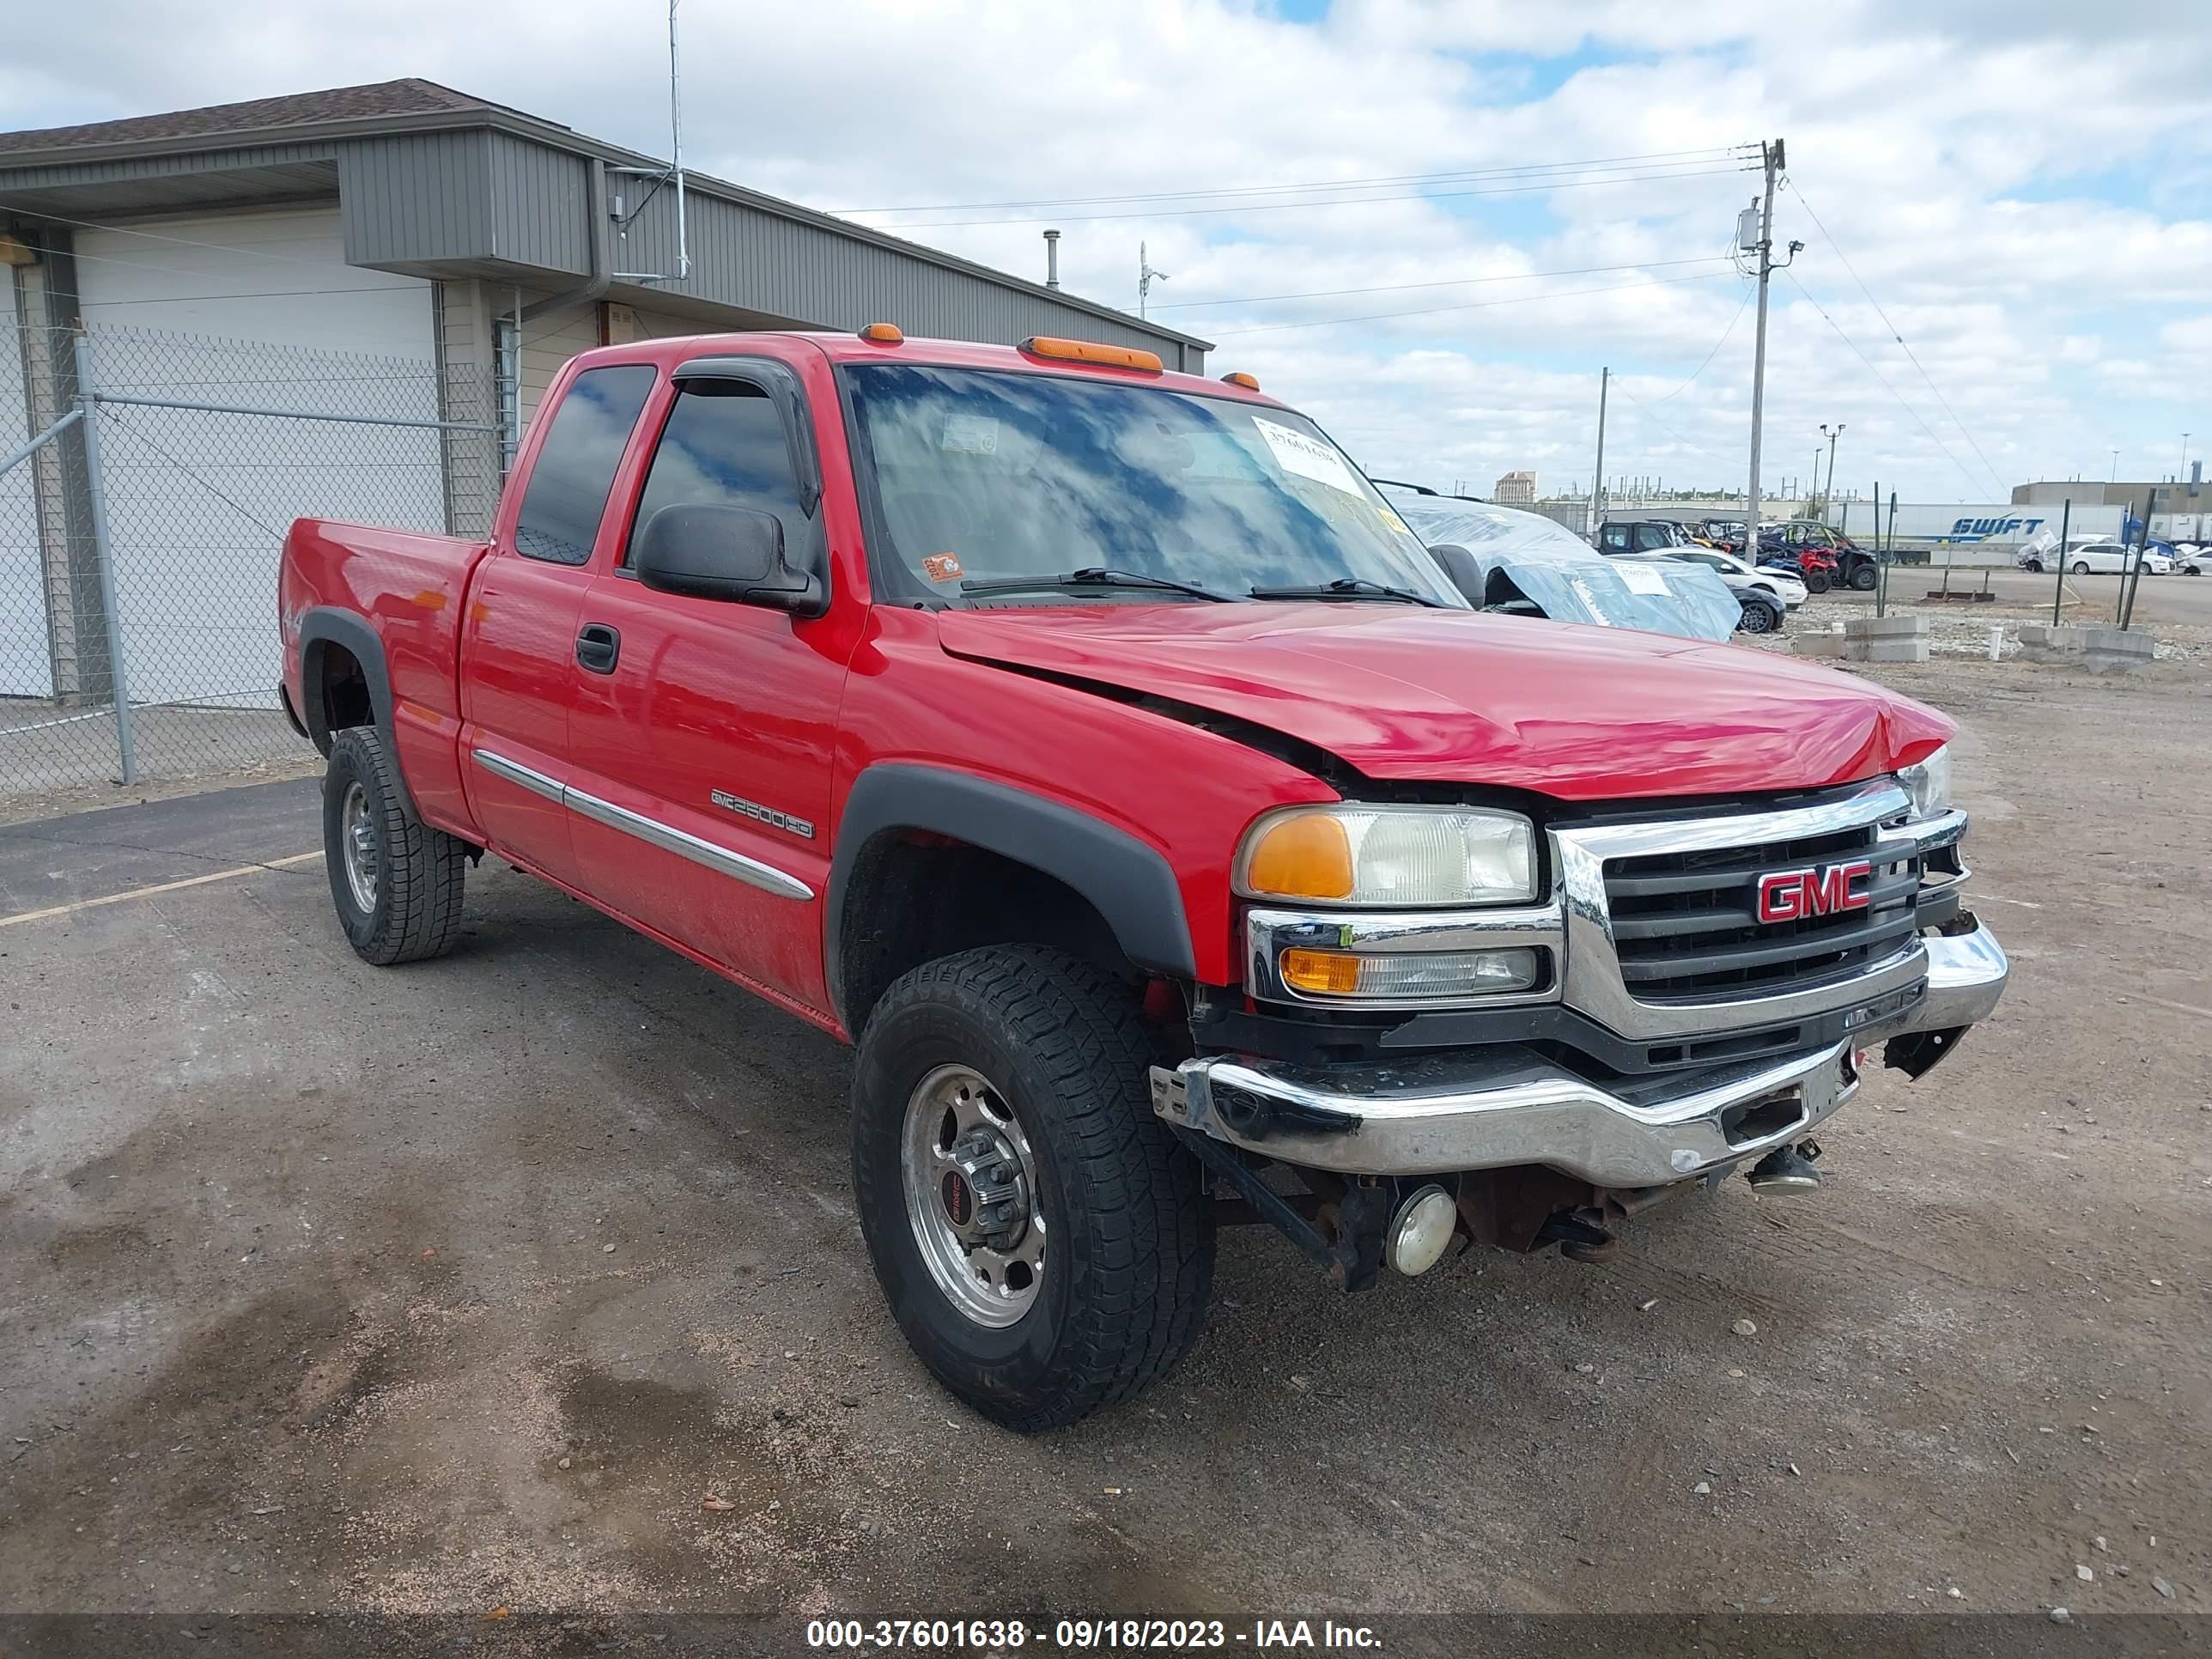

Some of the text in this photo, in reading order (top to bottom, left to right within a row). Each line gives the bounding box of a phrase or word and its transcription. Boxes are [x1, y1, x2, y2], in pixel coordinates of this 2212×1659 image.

[1954, 519, 2045, 534] SWIFT
[925, 559, 939, 578] 2022
[283, 601, 302, 634] 44
[1758, 860, 1870, 925] GMC
